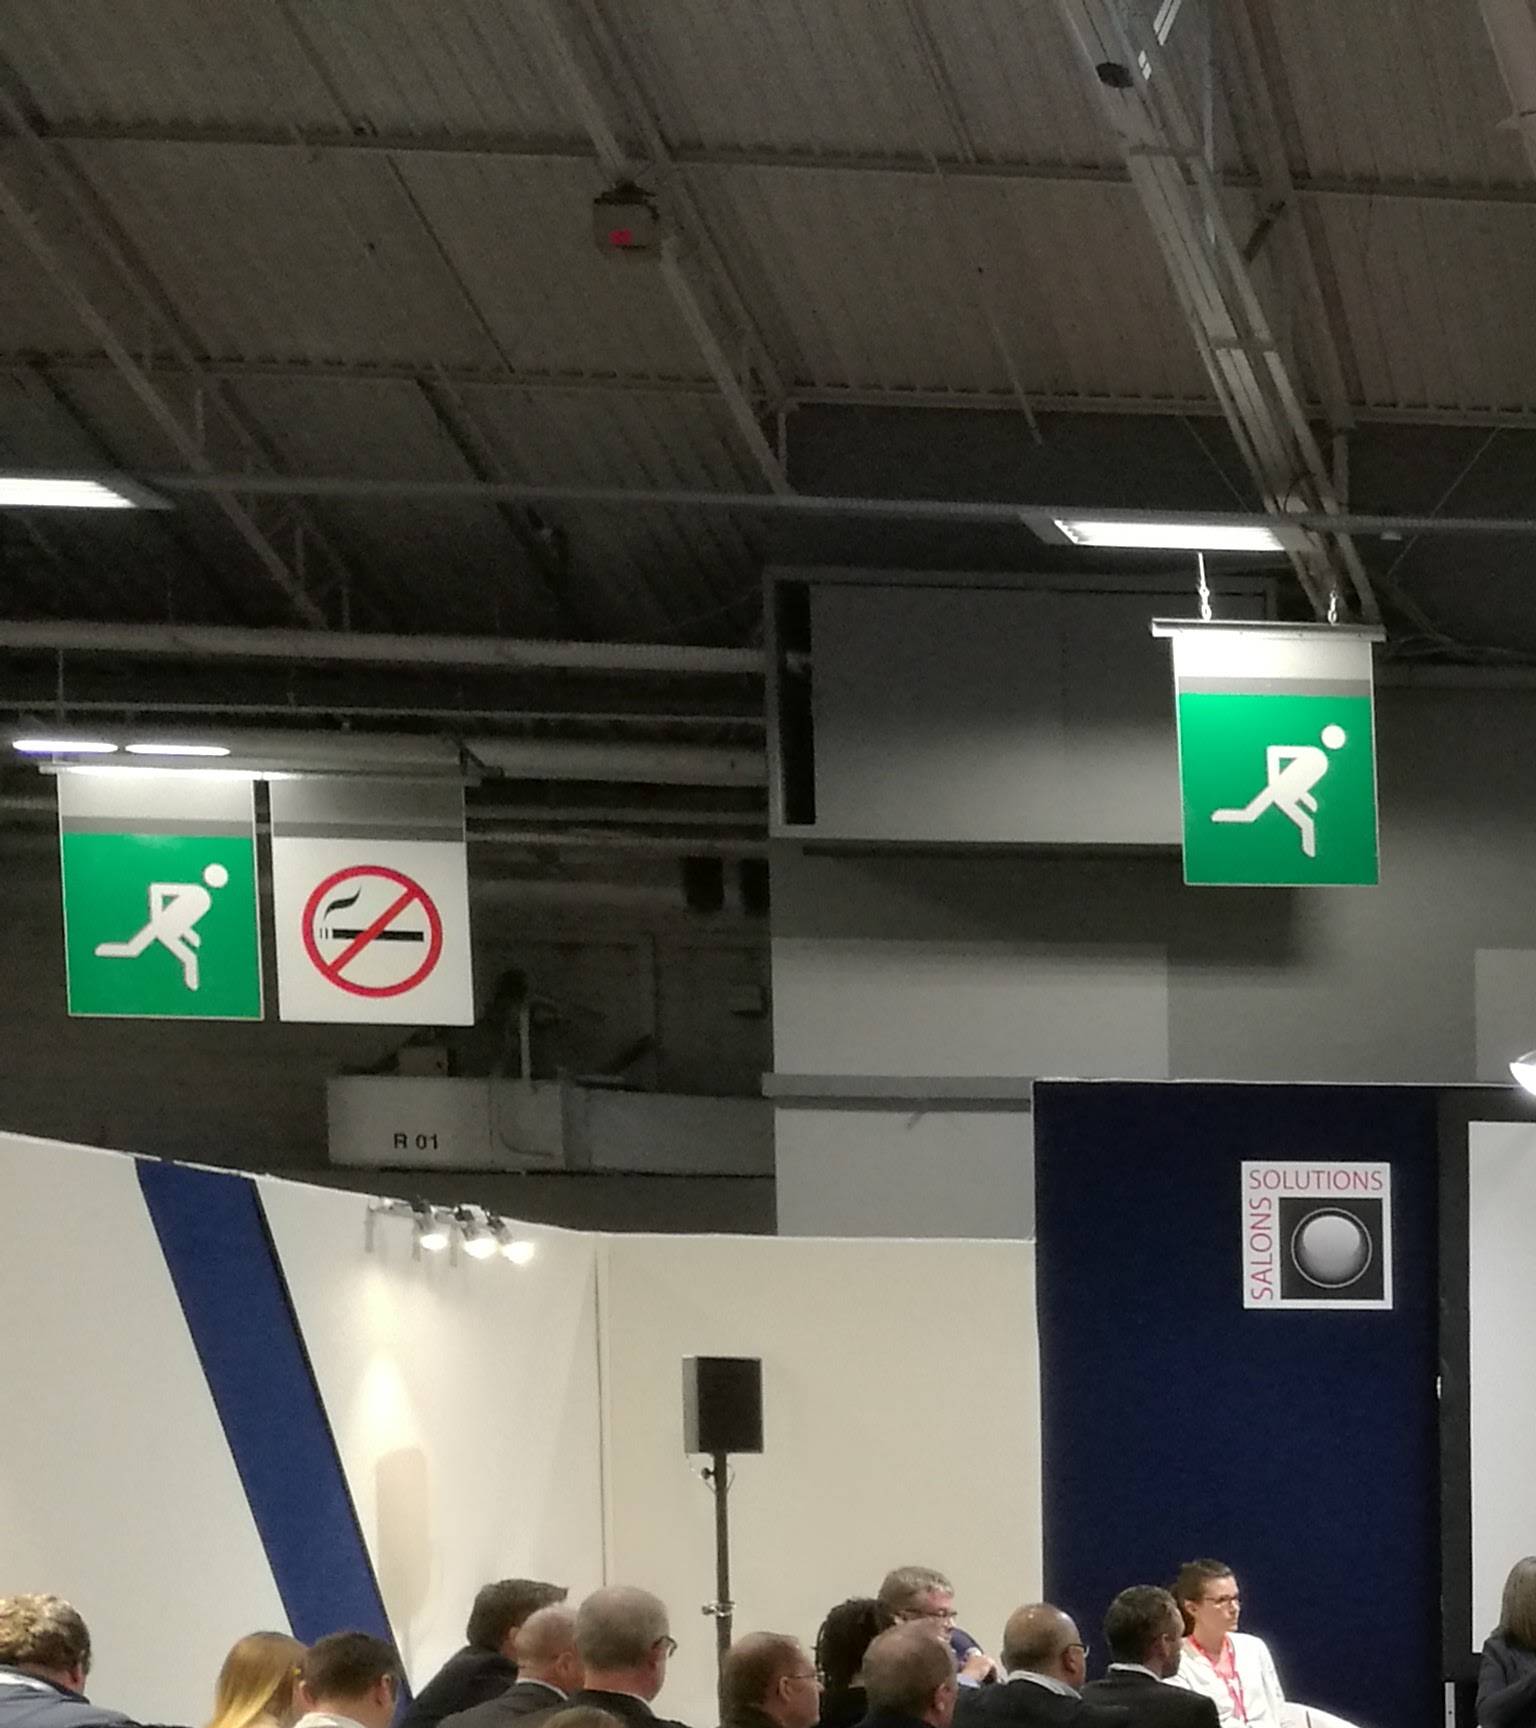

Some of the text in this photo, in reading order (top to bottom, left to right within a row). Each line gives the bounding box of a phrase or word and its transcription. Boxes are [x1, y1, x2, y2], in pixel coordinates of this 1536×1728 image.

[415, 1133, 438, 1150] 01
[1248, 1168, 1384, 1191] SOLUTIONS
[1247, 1196, 1274, 1301] SALONS
